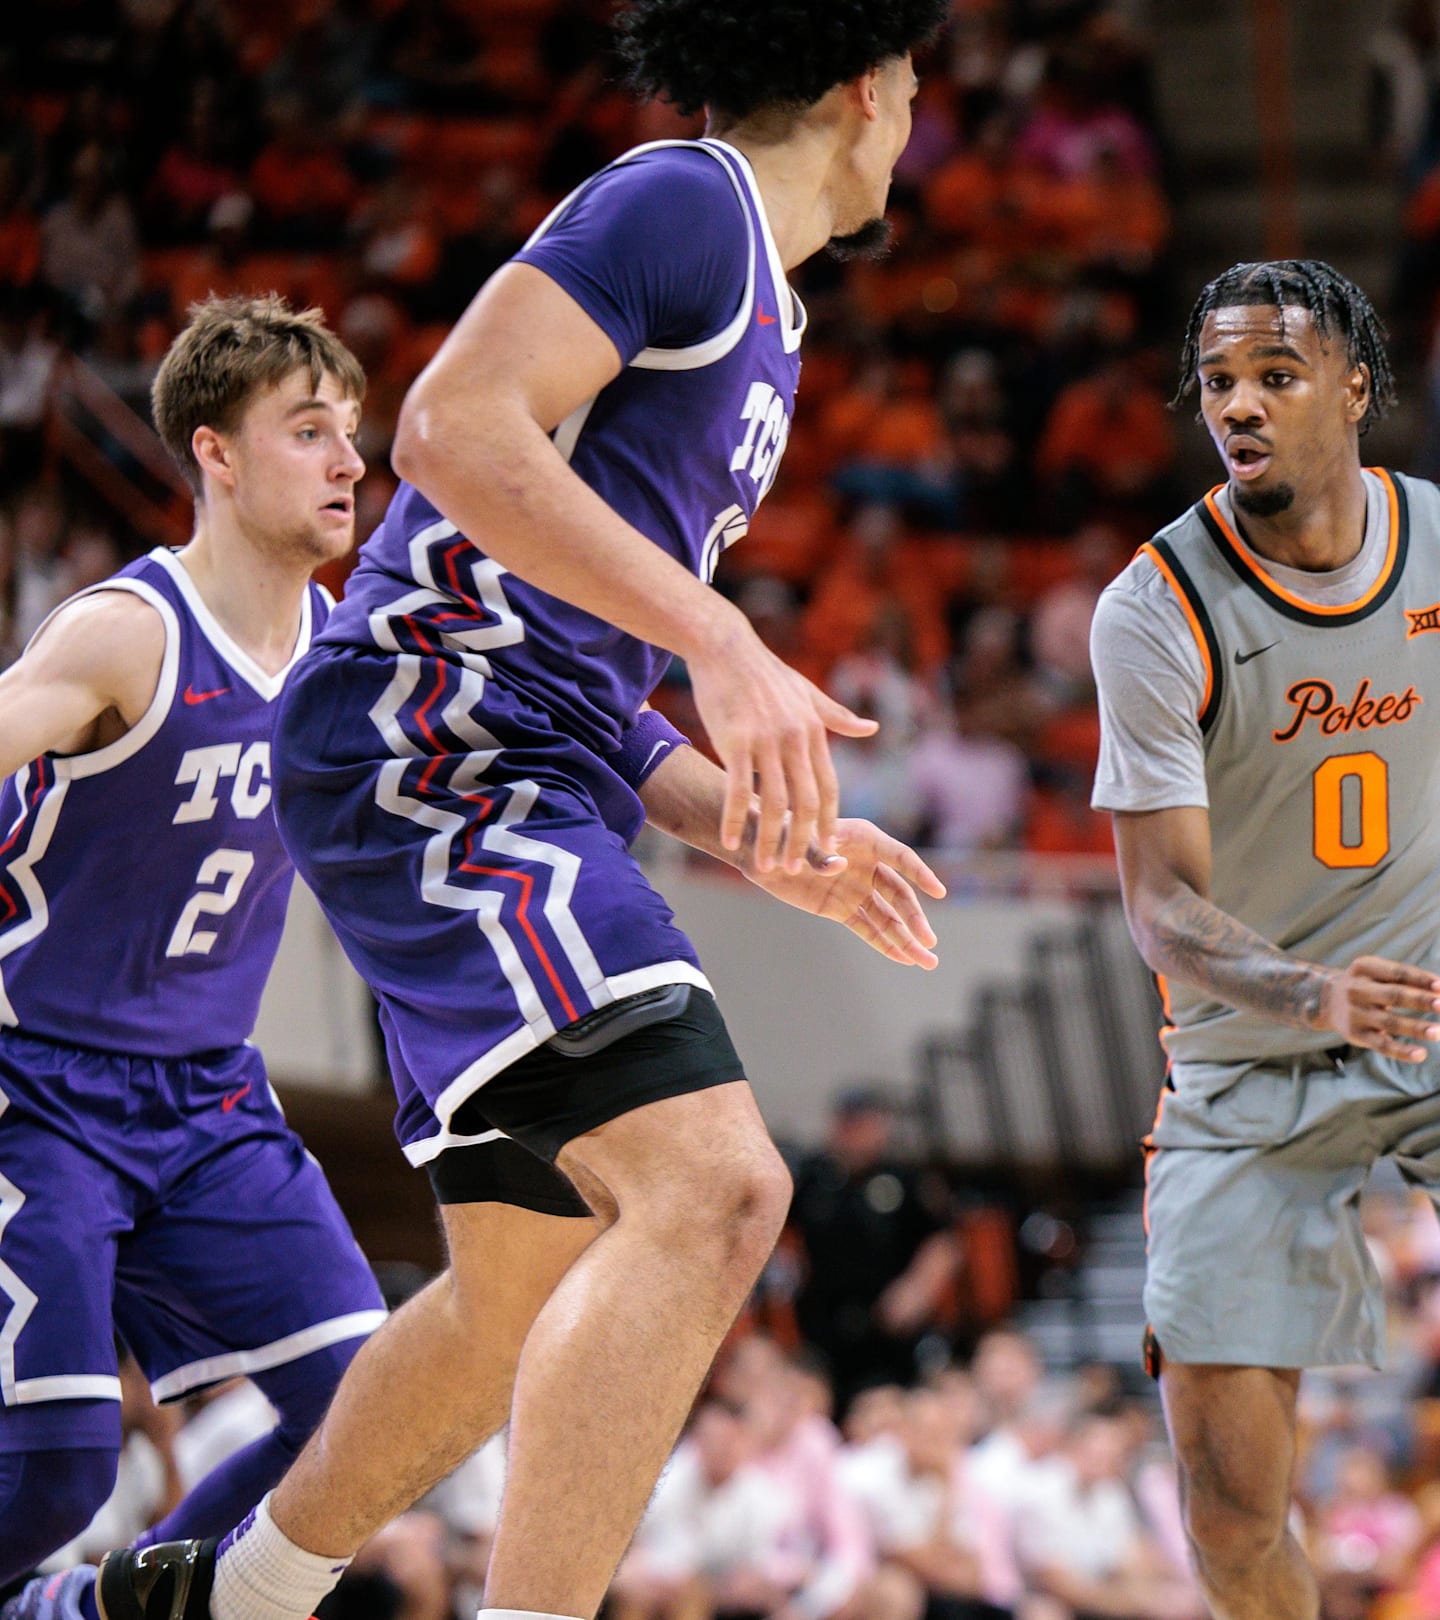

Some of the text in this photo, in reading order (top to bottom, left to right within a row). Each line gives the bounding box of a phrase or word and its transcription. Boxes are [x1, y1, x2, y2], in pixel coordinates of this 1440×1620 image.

[1271, 677, 1424, 744] Pokes
[172, 741, 272, 825] TC
[1313, 751, 1391, 870] 0
[165, 848, 255, 958] 2
